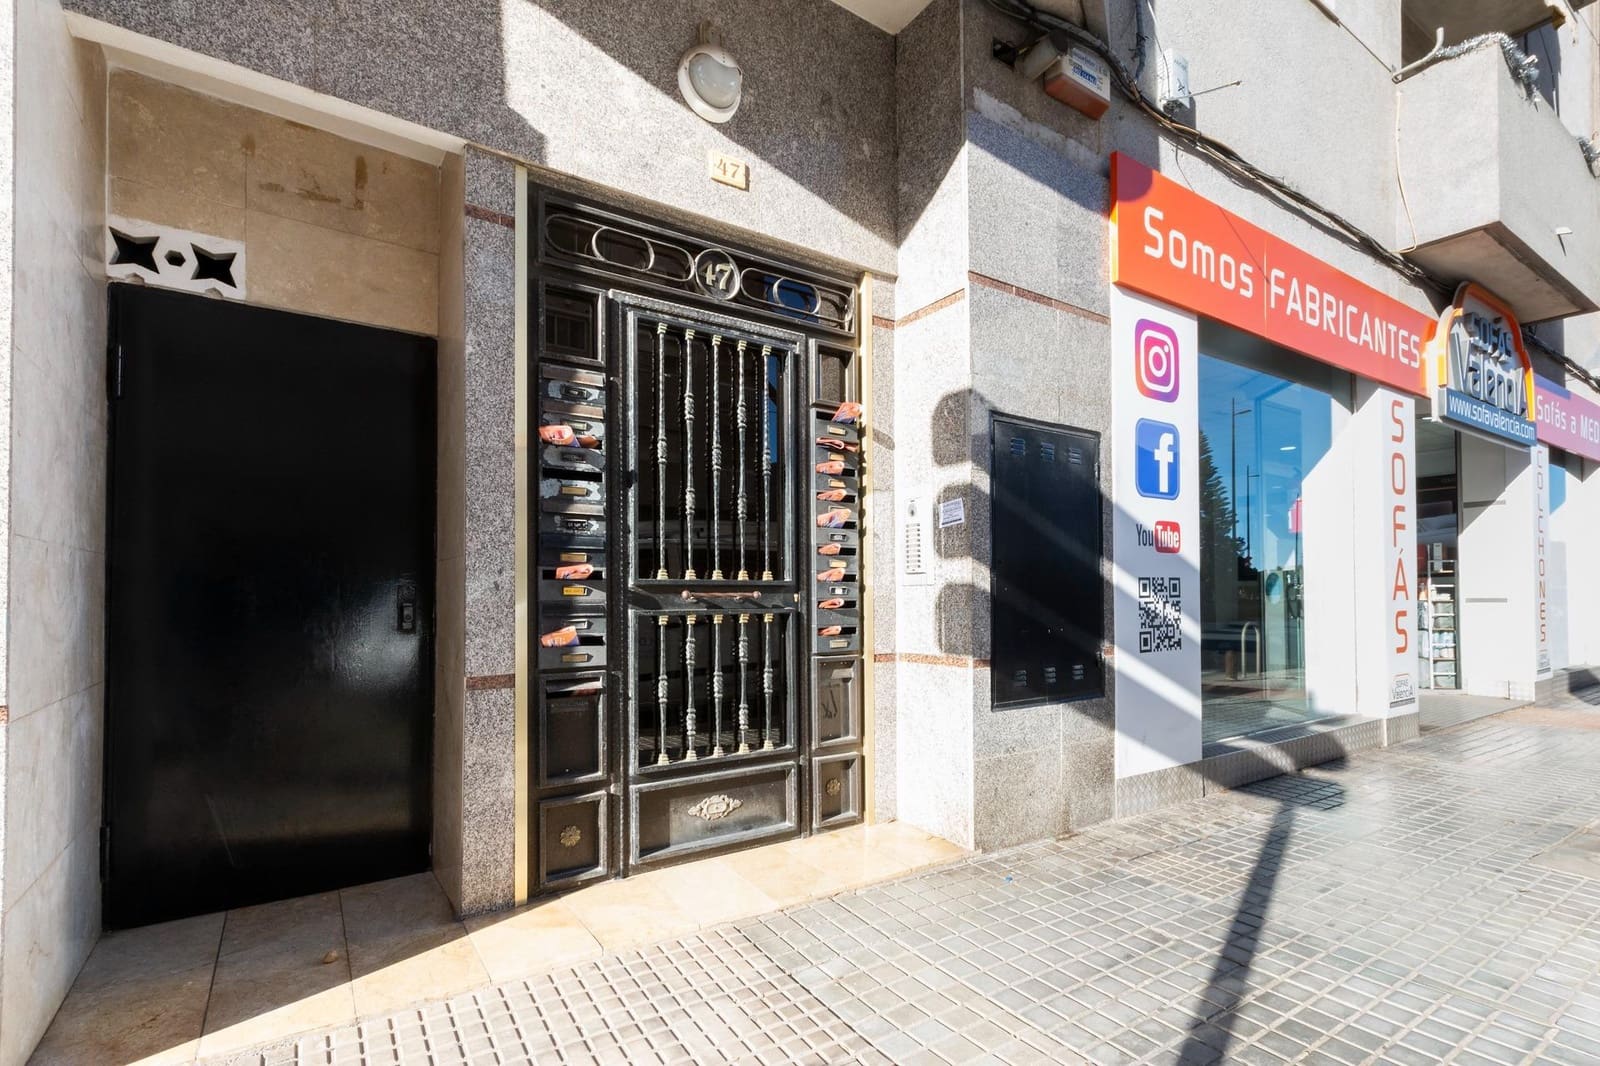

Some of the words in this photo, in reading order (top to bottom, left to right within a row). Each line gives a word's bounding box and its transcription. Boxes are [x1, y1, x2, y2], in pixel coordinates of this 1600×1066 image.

[716, 158, 740, 179] 47
[702, 261, 732, 290] 47
[1143, 206, 1253, 299] Somos
[1270, 268, 1421, 369] FABRICANTES
[1449, 395, 1535, 440] www.sofavalencia.com
[1537, 394, 1567, 430] Sofás
[1391, 399, 1409, 654] SOFÁS
[1536, 450, 1547, 642] COLCHONES
